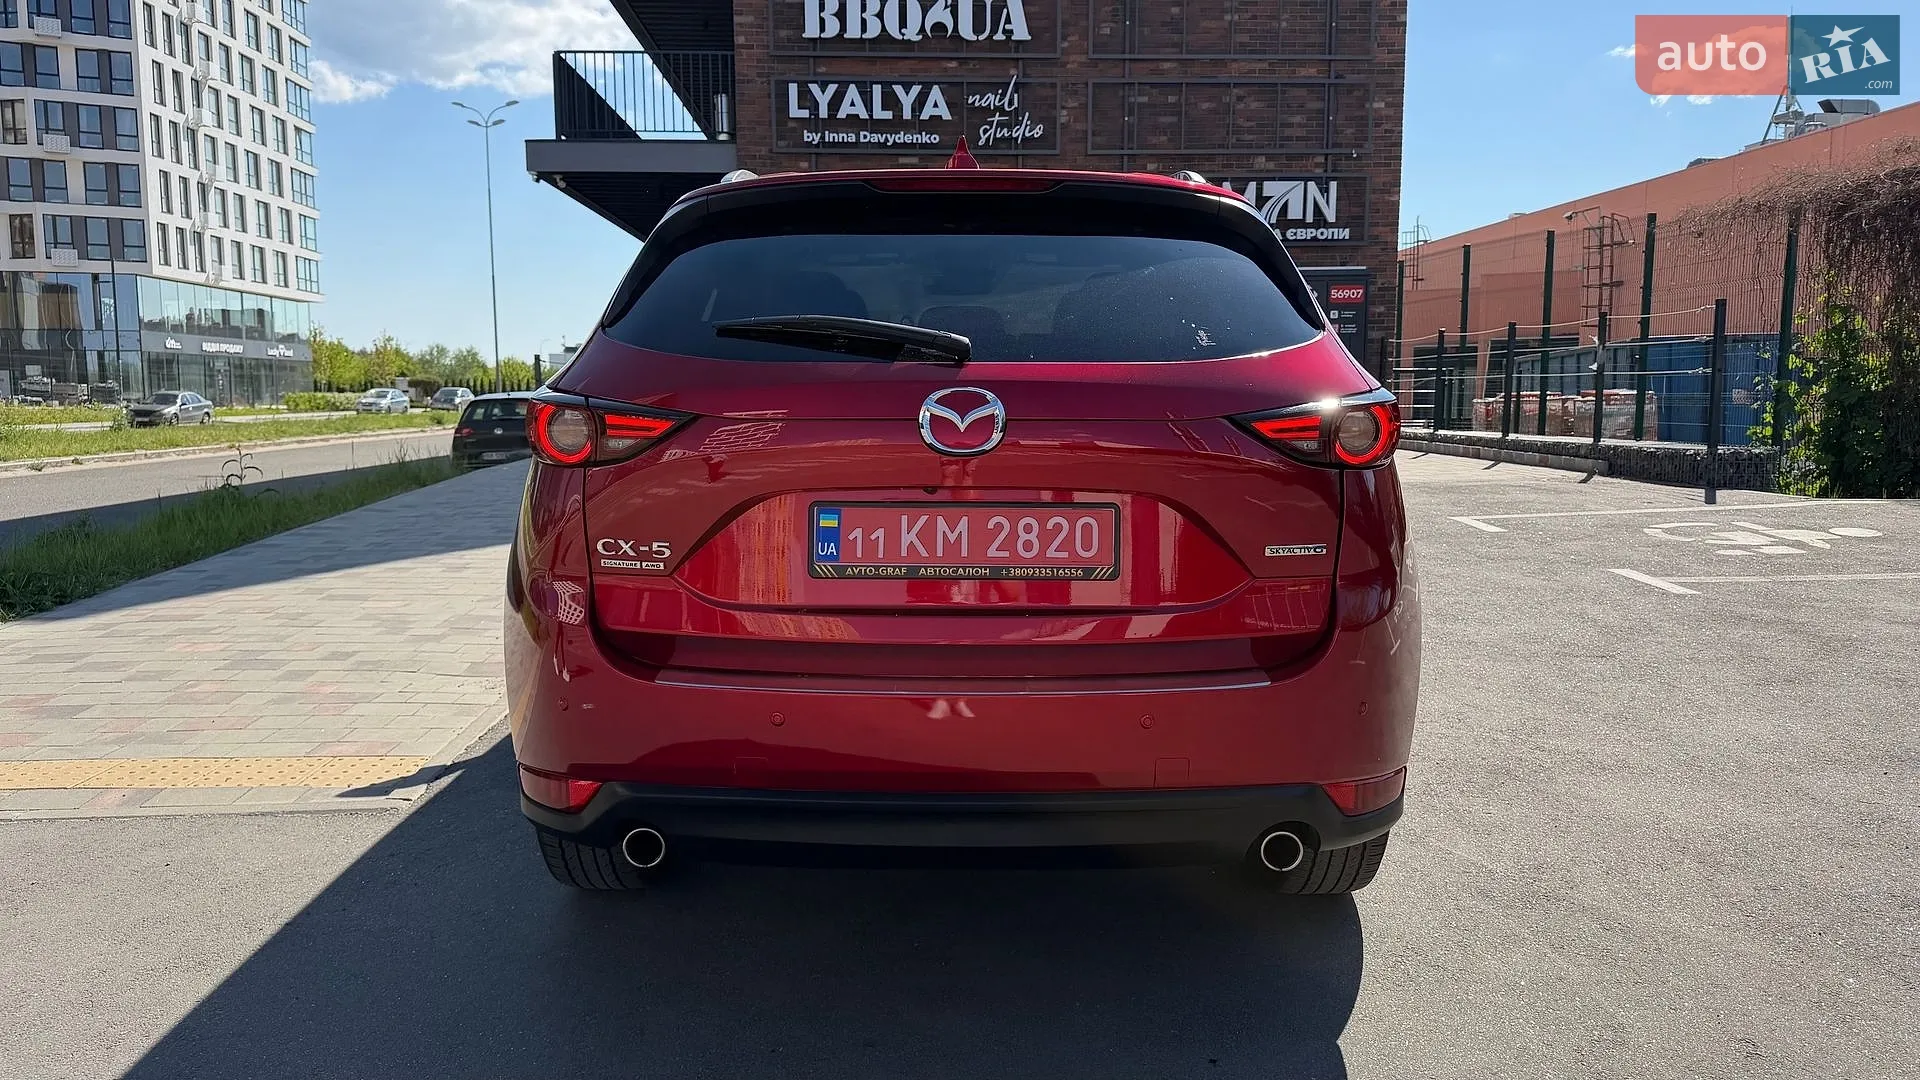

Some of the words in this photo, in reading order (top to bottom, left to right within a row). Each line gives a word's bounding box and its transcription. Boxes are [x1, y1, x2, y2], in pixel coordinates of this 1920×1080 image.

[788, 82, 953, 120] LYALYA
[978, 112, 1044, 146] studio
[803, 130, 821, 144] by
[824, 130, 856, 143] Inna
[859, 131, 940, 145] Davydenko
[1286, 227, 1350, 240] ЄВРОПИ
[1331, 289, 1364, 299] 56907
[847, 527, 886, 558] 11
[900, 514, 969, 558] KM
[986, 514, 1100, 558] 2820
[596, 538, 672, 558] CX-5
[818, 542, 837, 556] UA
[602, 560, 638, 568] SIGNATURE
[845, 566, 908, 576] AVTO-GRAF
[918, 566, 990, 577] АВТОСАЛОН
[1000, 567, 1084, 578] +380933516556
